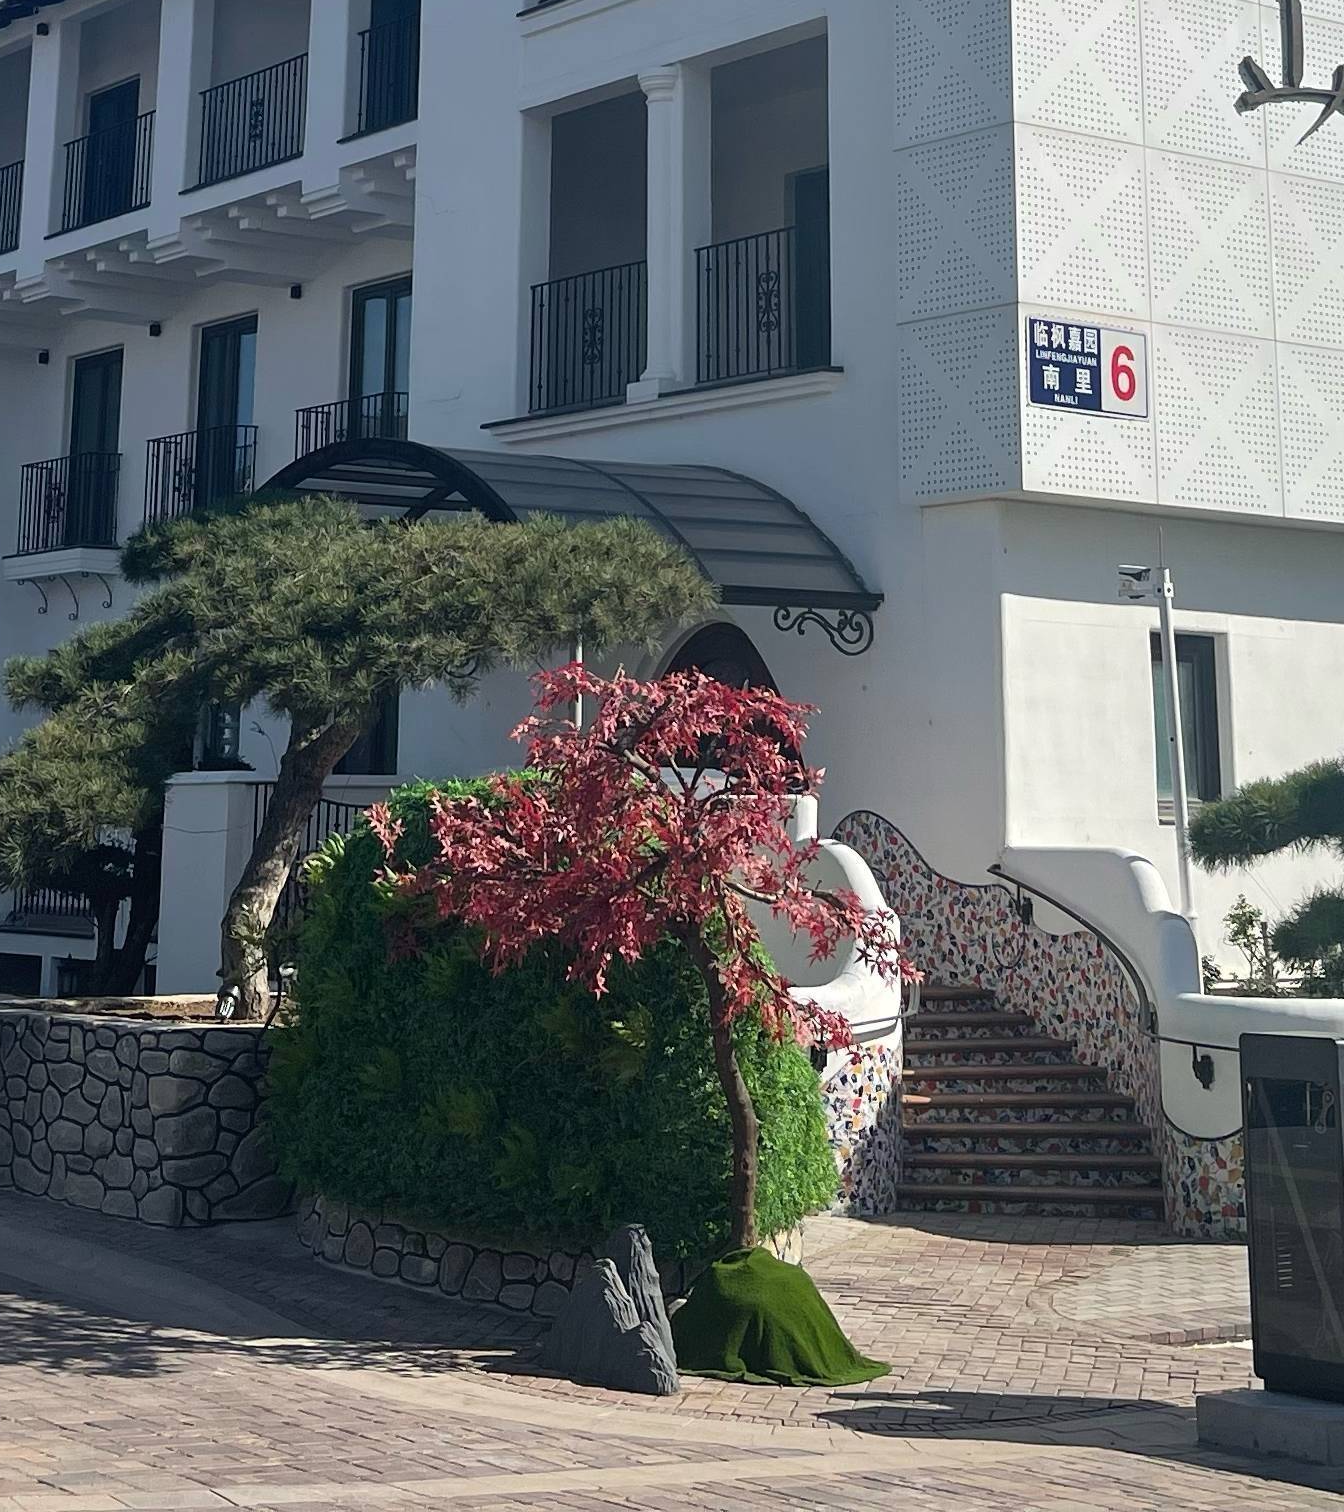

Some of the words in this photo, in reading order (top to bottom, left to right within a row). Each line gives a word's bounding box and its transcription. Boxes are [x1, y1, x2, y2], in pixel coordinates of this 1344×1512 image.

[1033, 320, 1098, 355] 临枫嘉园
[1035, 349, 1097, 367] LINFENGJIAYUAN
[1111, 345, 1136, 402] 6
[1042, 364, 1093, 395] 南里
[1054, 393, 1079, 405] NANLI
